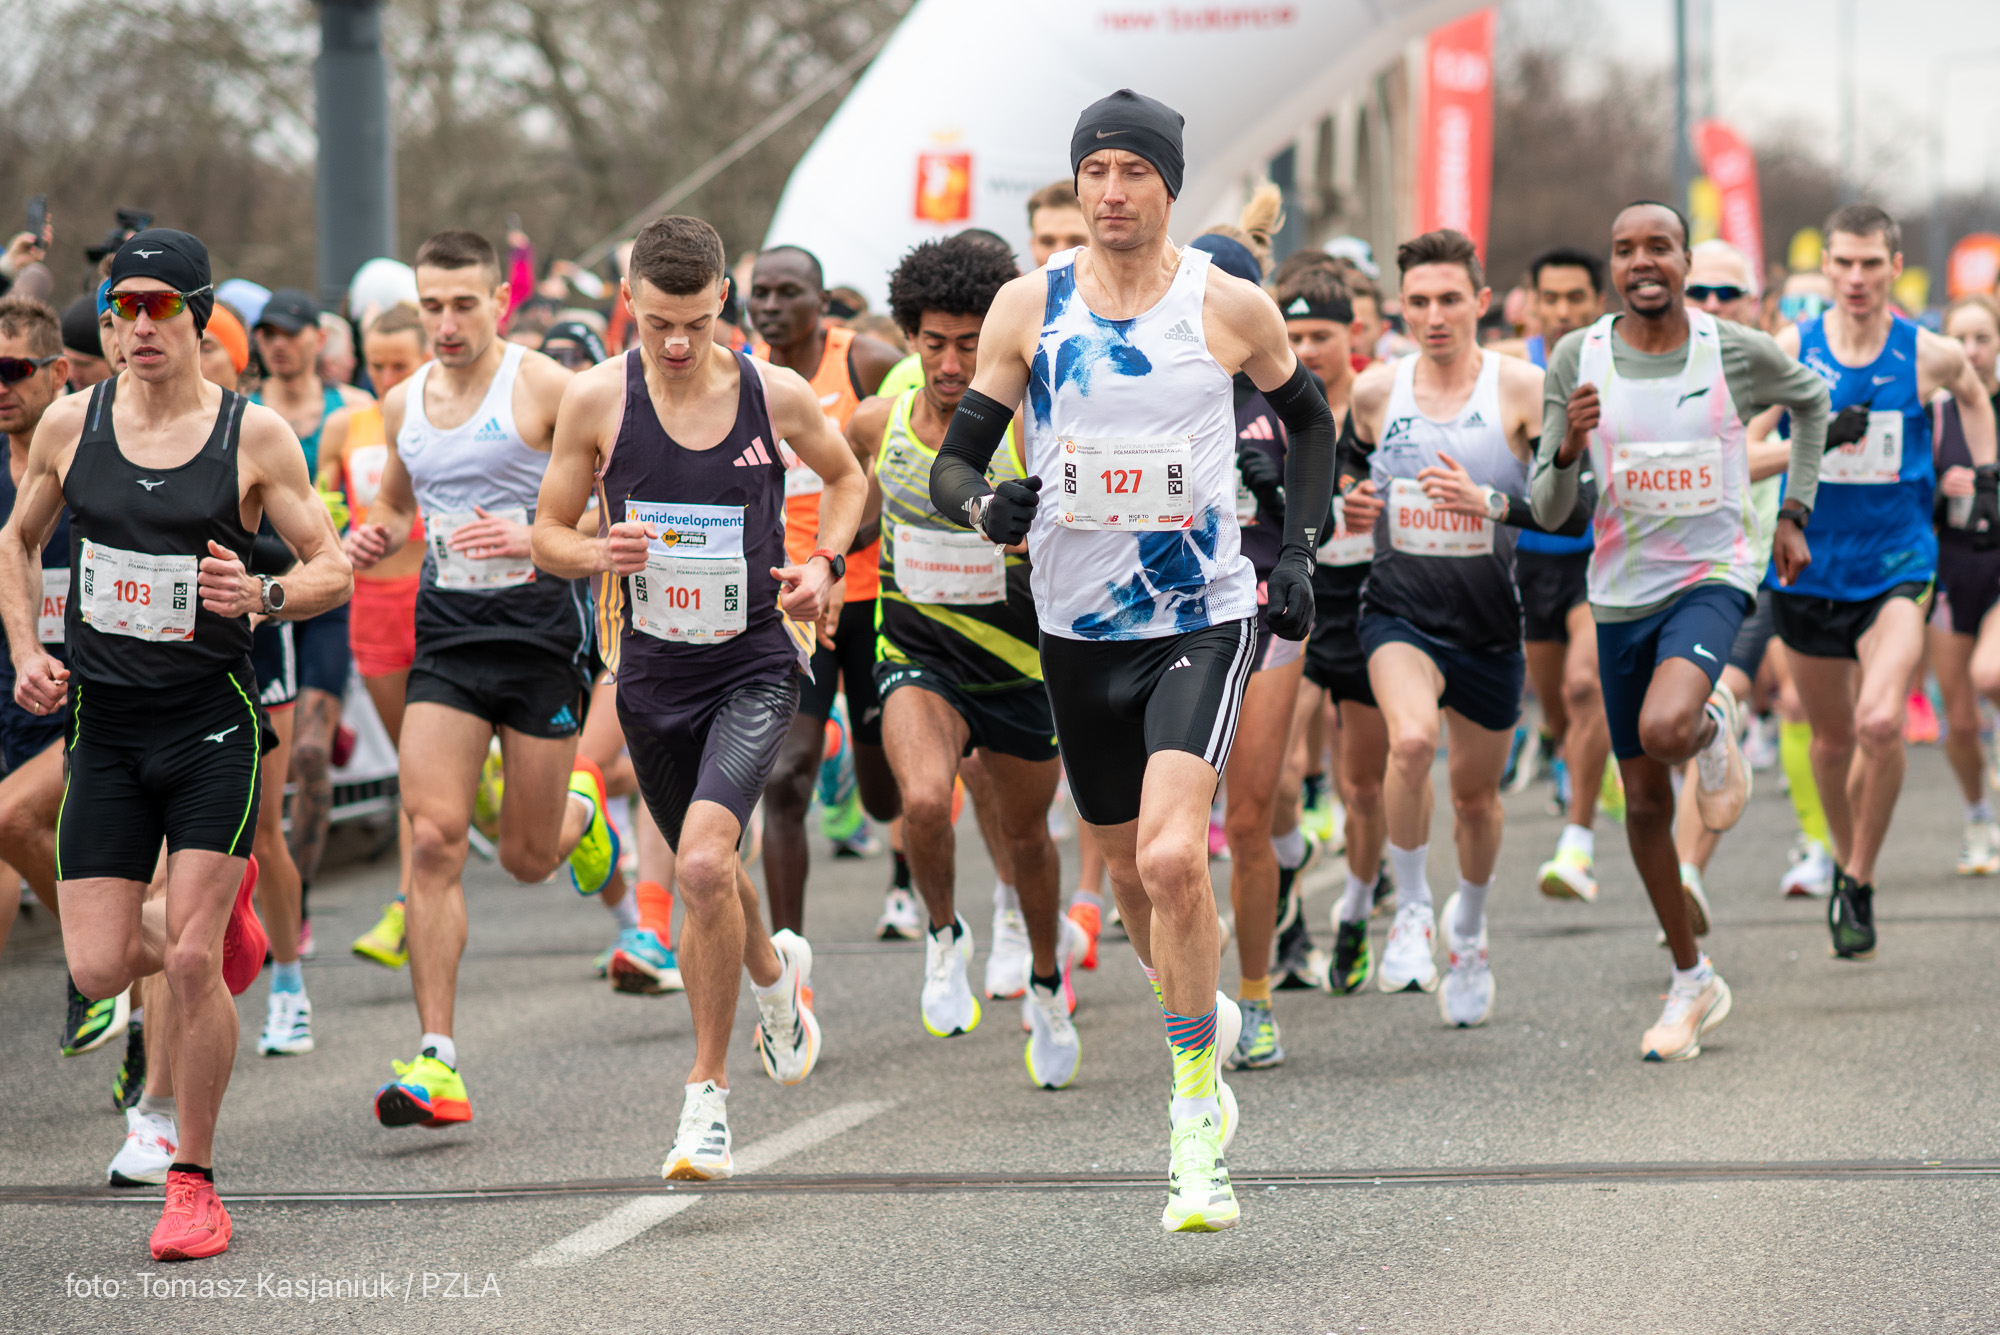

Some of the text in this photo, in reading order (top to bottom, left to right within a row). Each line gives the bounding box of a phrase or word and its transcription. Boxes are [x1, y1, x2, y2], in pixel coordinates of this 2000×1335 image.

[1164, 332, 1199, 343] adidas
[1100, 469, 1143, 494] 127
[1626, 465, 1712, 491] PACER 5
[640, 511, 744, 529] unidevelopment
[1398, 507, 1483, 532] BOULVIN
[680, 535, 705, 544] OPTIMA
[113, 579, 151, 606] 103
[665, 586, 700, 610] 101
